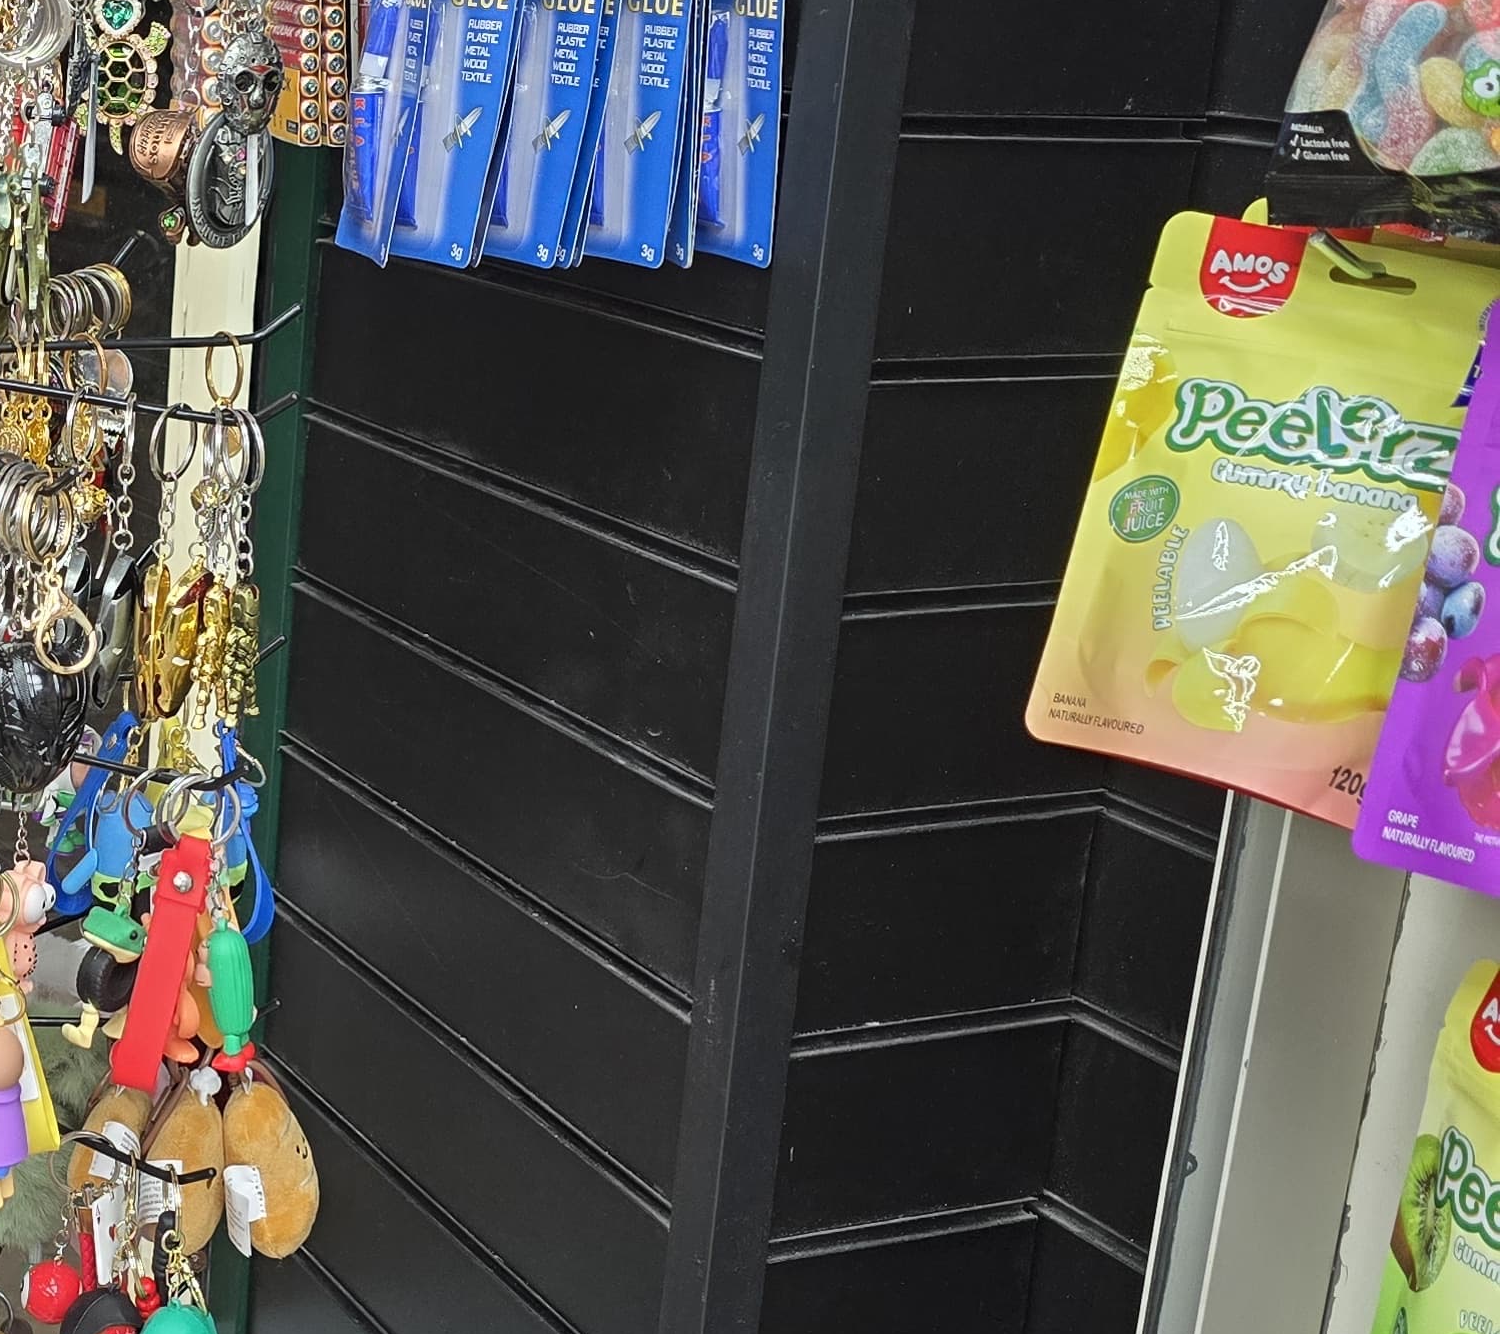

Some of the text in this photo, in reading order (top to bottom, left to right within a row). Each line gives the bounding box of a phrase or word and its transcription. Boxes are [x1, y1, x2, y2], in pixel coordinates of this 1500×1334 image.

[467, 19, 503, 31] RUBBER
[557, 22, 590, 35] RUBBER
[643, 24, 678, 38] RUBBER
[466, 32, 500, 44] PLASTIC
[748, 27, 776, 41] RUBBER
[555, 36, 587, 48] PLASTIC
[642, 37, 676, 50] PLASTIC
[747, 40, 774, 54] PLASTIC
[464, 45, 491, 57] METAL
[553, 49, 579, 61] METAL
[641, 50, 668, 63] METAL
[463, 58, 488, 70] WOOD
[460, 70, 493, 84] TEXTILE
[550, 74, 581, 87] TEXTILE
[638, 75, 671, 88] TEXTILE
[746, 77, 772, 91] TEXTILE
[450, 243, 464, 261] 3g
[536, 243, 550, 262] 3g
[640, 243, 655, 262] 3g
[752, 243, 766, 261] 3g
[1209, 248, 1290, 285] AMOS
[1123, 485, 1170, 501] MADE WITH
[1316, 468, 1419, 512] banana
[1129, 496, 1165, 516] FRUIT
[1122, 512, 1166, 534] JUICE
[1152, 524, 1190, 631] PEELABLE
[1052, 692, 1087, 709] BANANA
[1048, 707, 1145, 736] NATURALLY FLAVOURED
[1387, 809, 1419, 829] GRAPE
[1381, 824, 1431, 851] NATURALLY
[1429, 837, 1476, 863] FLAVOURED
